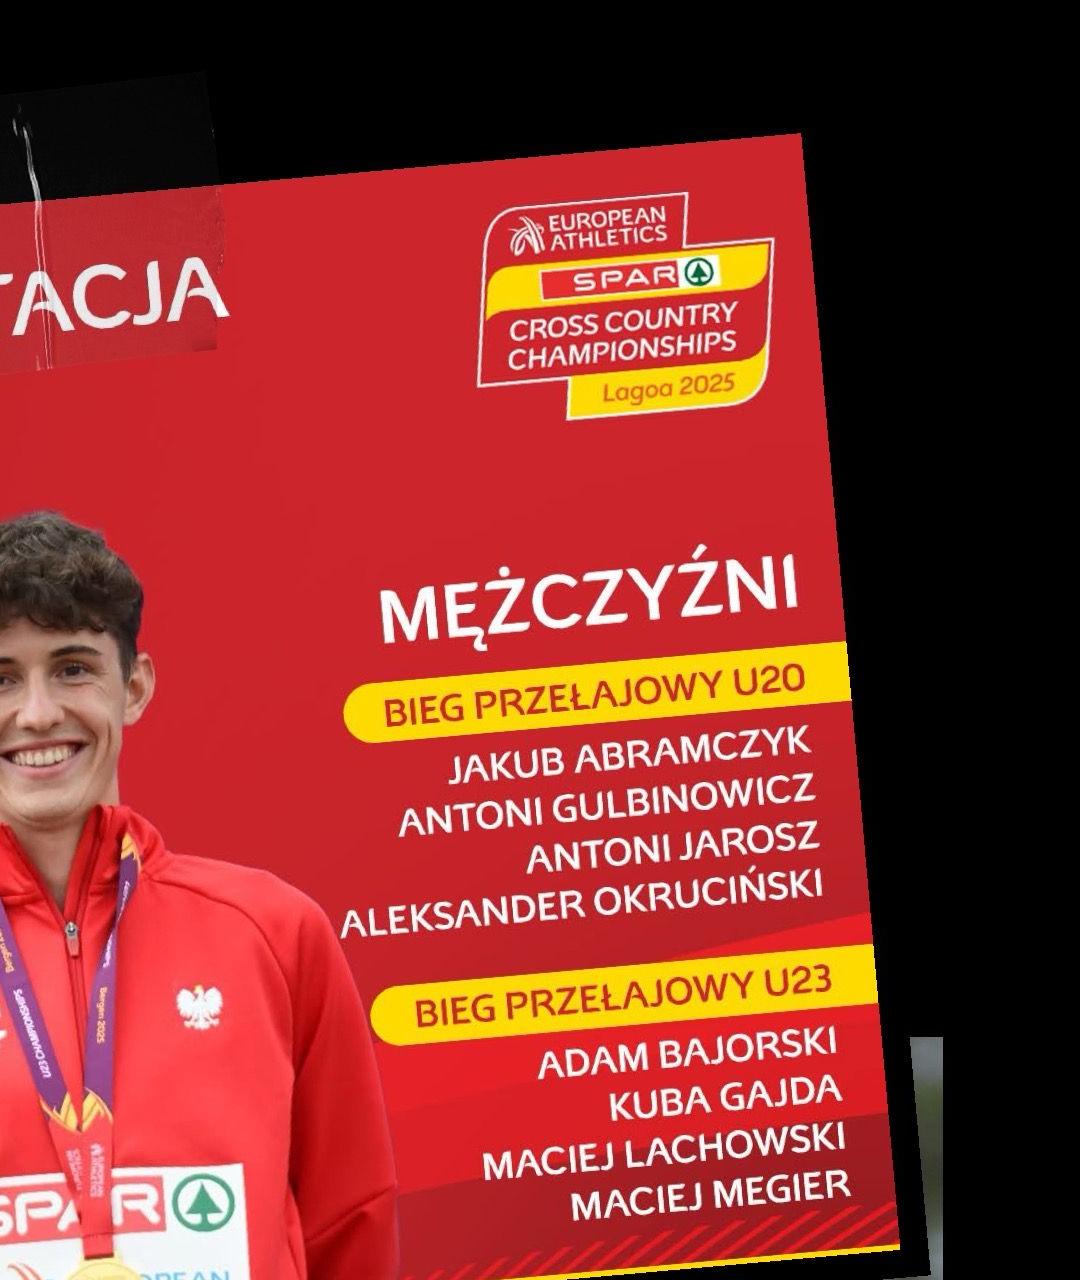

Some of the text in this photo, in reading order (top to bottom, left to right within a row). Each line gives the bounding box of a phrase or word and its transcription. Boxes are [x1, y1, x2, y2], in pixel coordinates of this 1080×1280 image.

[548, 205, 667, 233] EUROPEAN
[550, 224, 668, 252] ATHLETICS
[573, 264, 678, 292] SPAR
[509, 300, 739, 342] CROSS COUNTRY
[507, 329, 738, 371] CHAMPIONSHIPS
[603, 372, 736, 406] Lagoa 2025
[379, 543, 798, 652] MĘŻCZYŹNI
[384, 662, 806, 728] BIEG PRZEŁAJOWY U20
[448, 724, 812, 785] JAKUB ABRAMCZYK
[398, 772, 817, 838] ANTONI GULBINOWICZ
[526, 820, 821, 875] ANTONI JAROSZ
[340, 864, 823, 939] ALEKSANDER OKRUCIŃSKI
[415, 963, 832, 1028] BIEG PRZEŁAJOWY U23
[537, 1025, 837, 1080] ADAM BAJORSKI
[609, 1074, 843, 1122] KUBA GAJDA
[482, 1121, 846, 1181] MACIEJ LACHOWSKI
[570, 1169, 852, 1222] MACIEJ MEGIER
